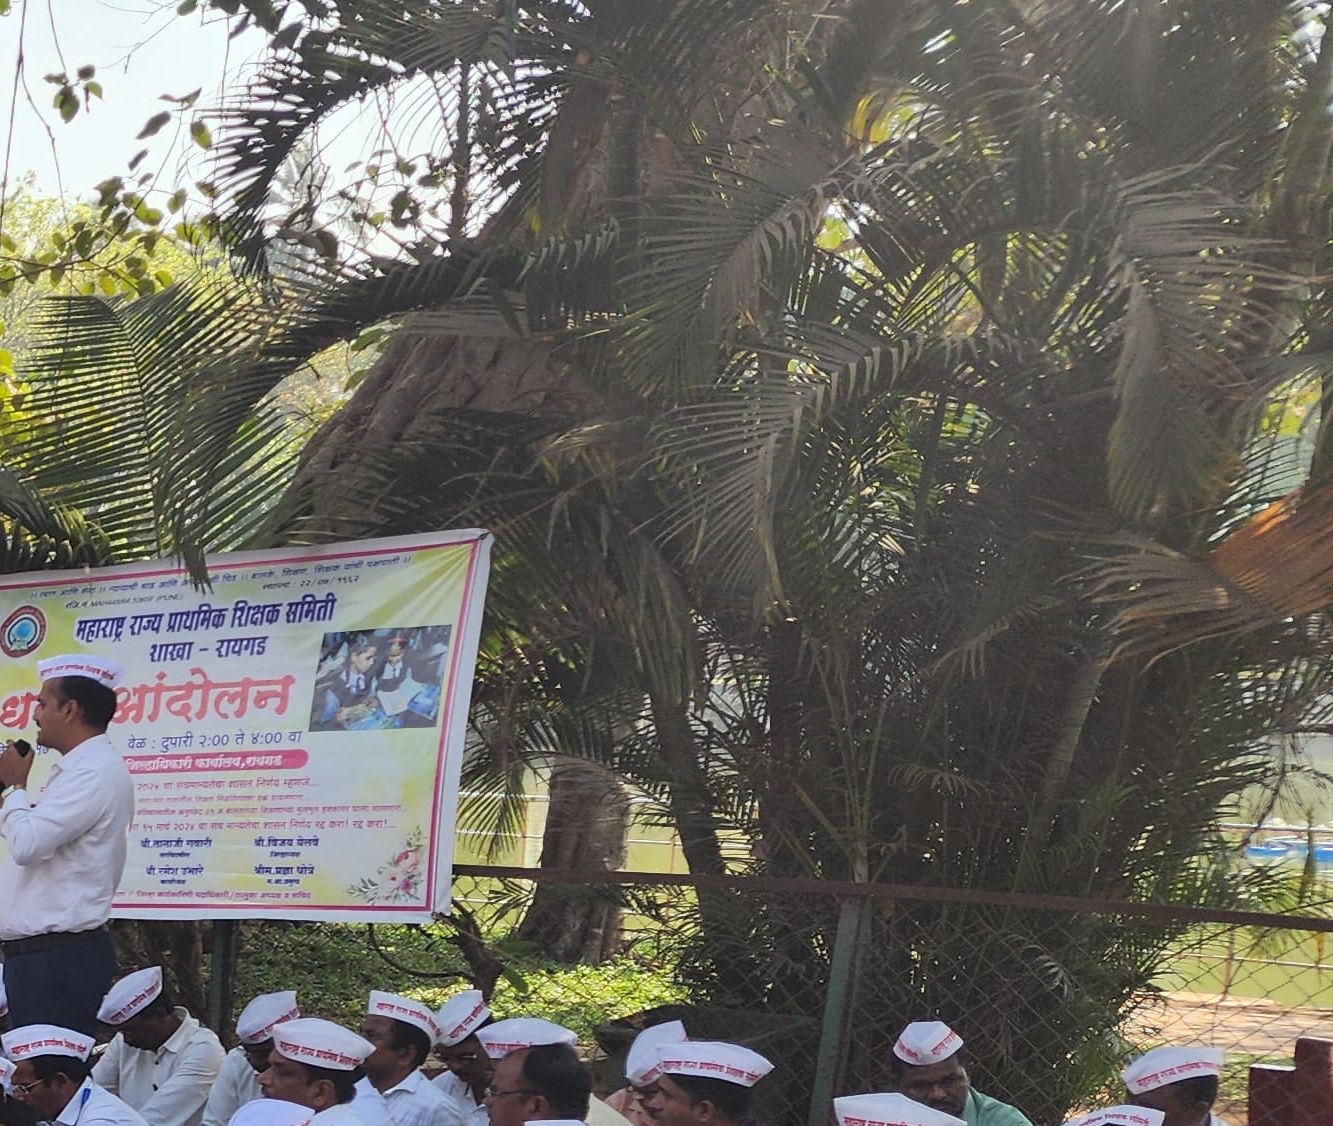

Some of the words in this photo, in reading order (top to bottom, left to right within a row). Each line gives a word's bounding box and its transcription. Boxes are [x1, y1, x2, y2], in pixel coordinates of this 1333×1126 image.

[76, 616, 126, 642] महाराष्ट्र
[130, 613, 164, 636] राज्य
[166, 602, 228, 633] प्राथमिक
[231, 600, 282, 629] शिक्षक
[285, 592, 337, 624] समिती
[150, 642, 194, 663] शाखा
[216, 636, 269, 658] रायगड
[112, 667, 296, 725] आंदोलन
[128, 734, 147, 749] वेळ
[161, 731, 193, 753] दुपारी
[235, 729, 246, 745] ते
